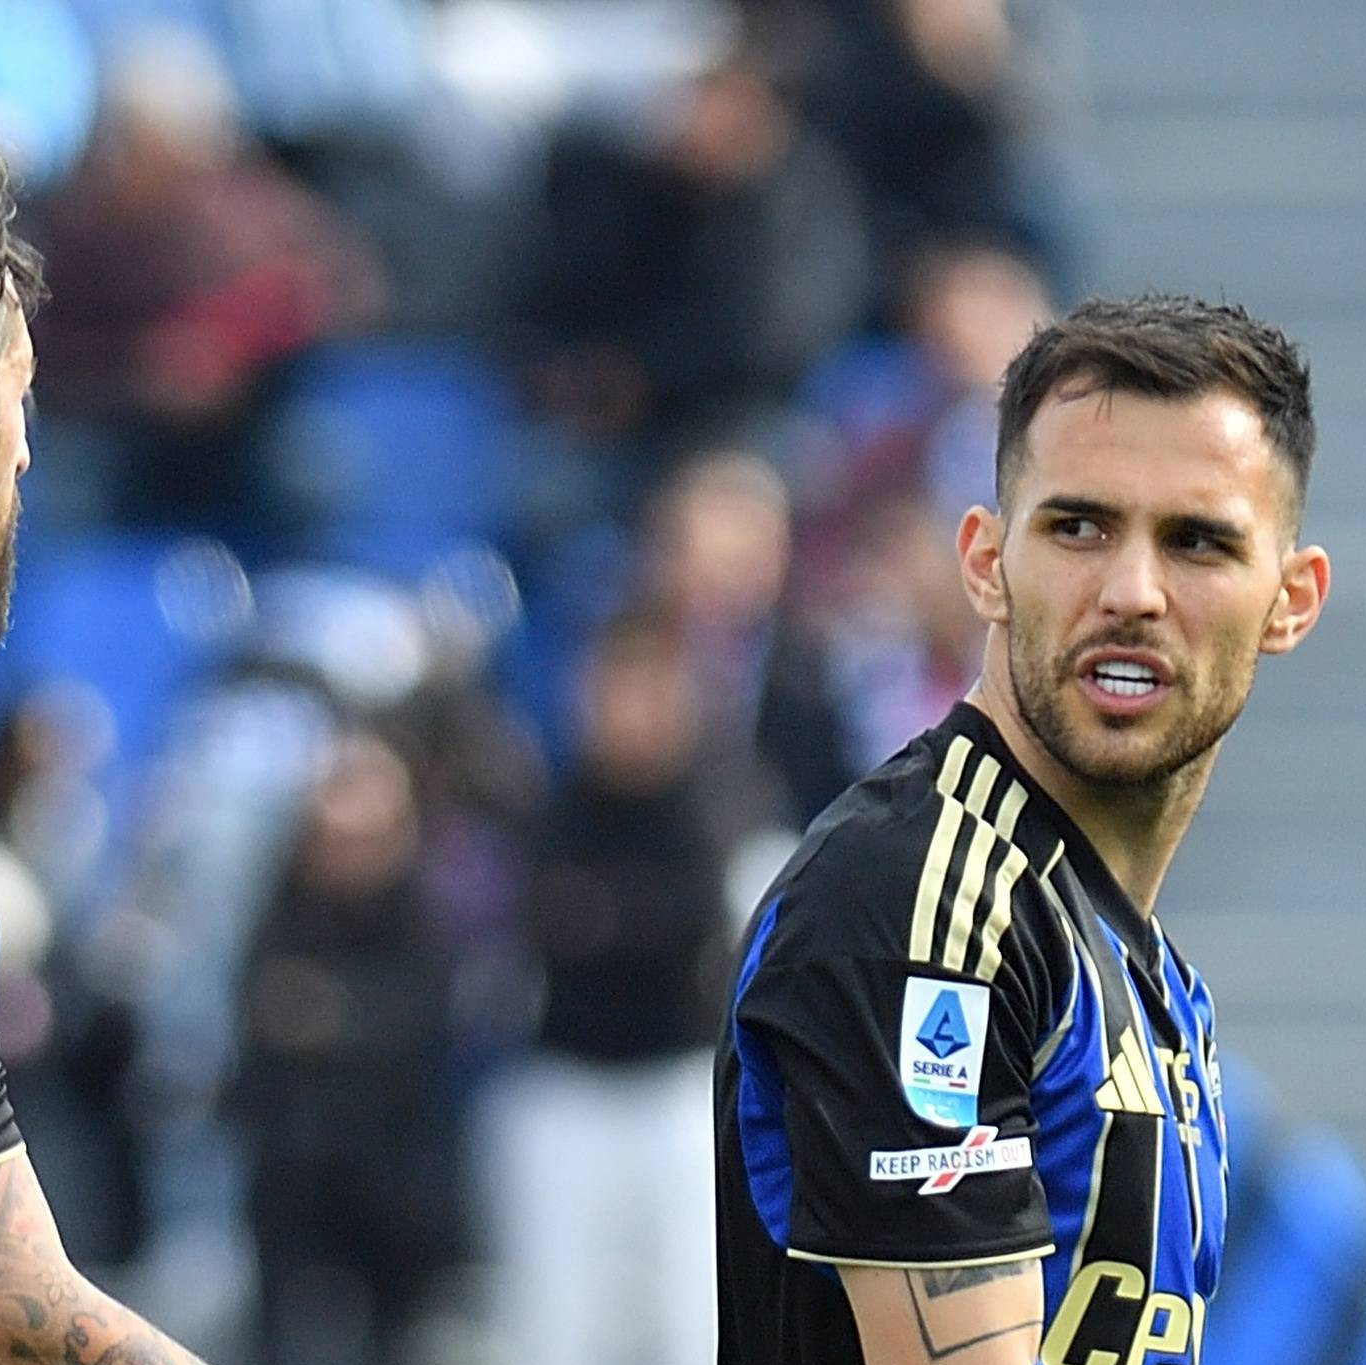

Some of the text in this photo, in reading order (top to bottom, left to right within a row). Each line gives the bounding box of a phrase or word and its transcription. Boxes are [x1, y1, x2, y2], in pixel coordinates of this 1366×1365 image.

[913, 1060, 968, 1079] SERIE A
[876, 1155, 921, 1174] KEEP
[928, 1148, 996, 1170] RACISM
